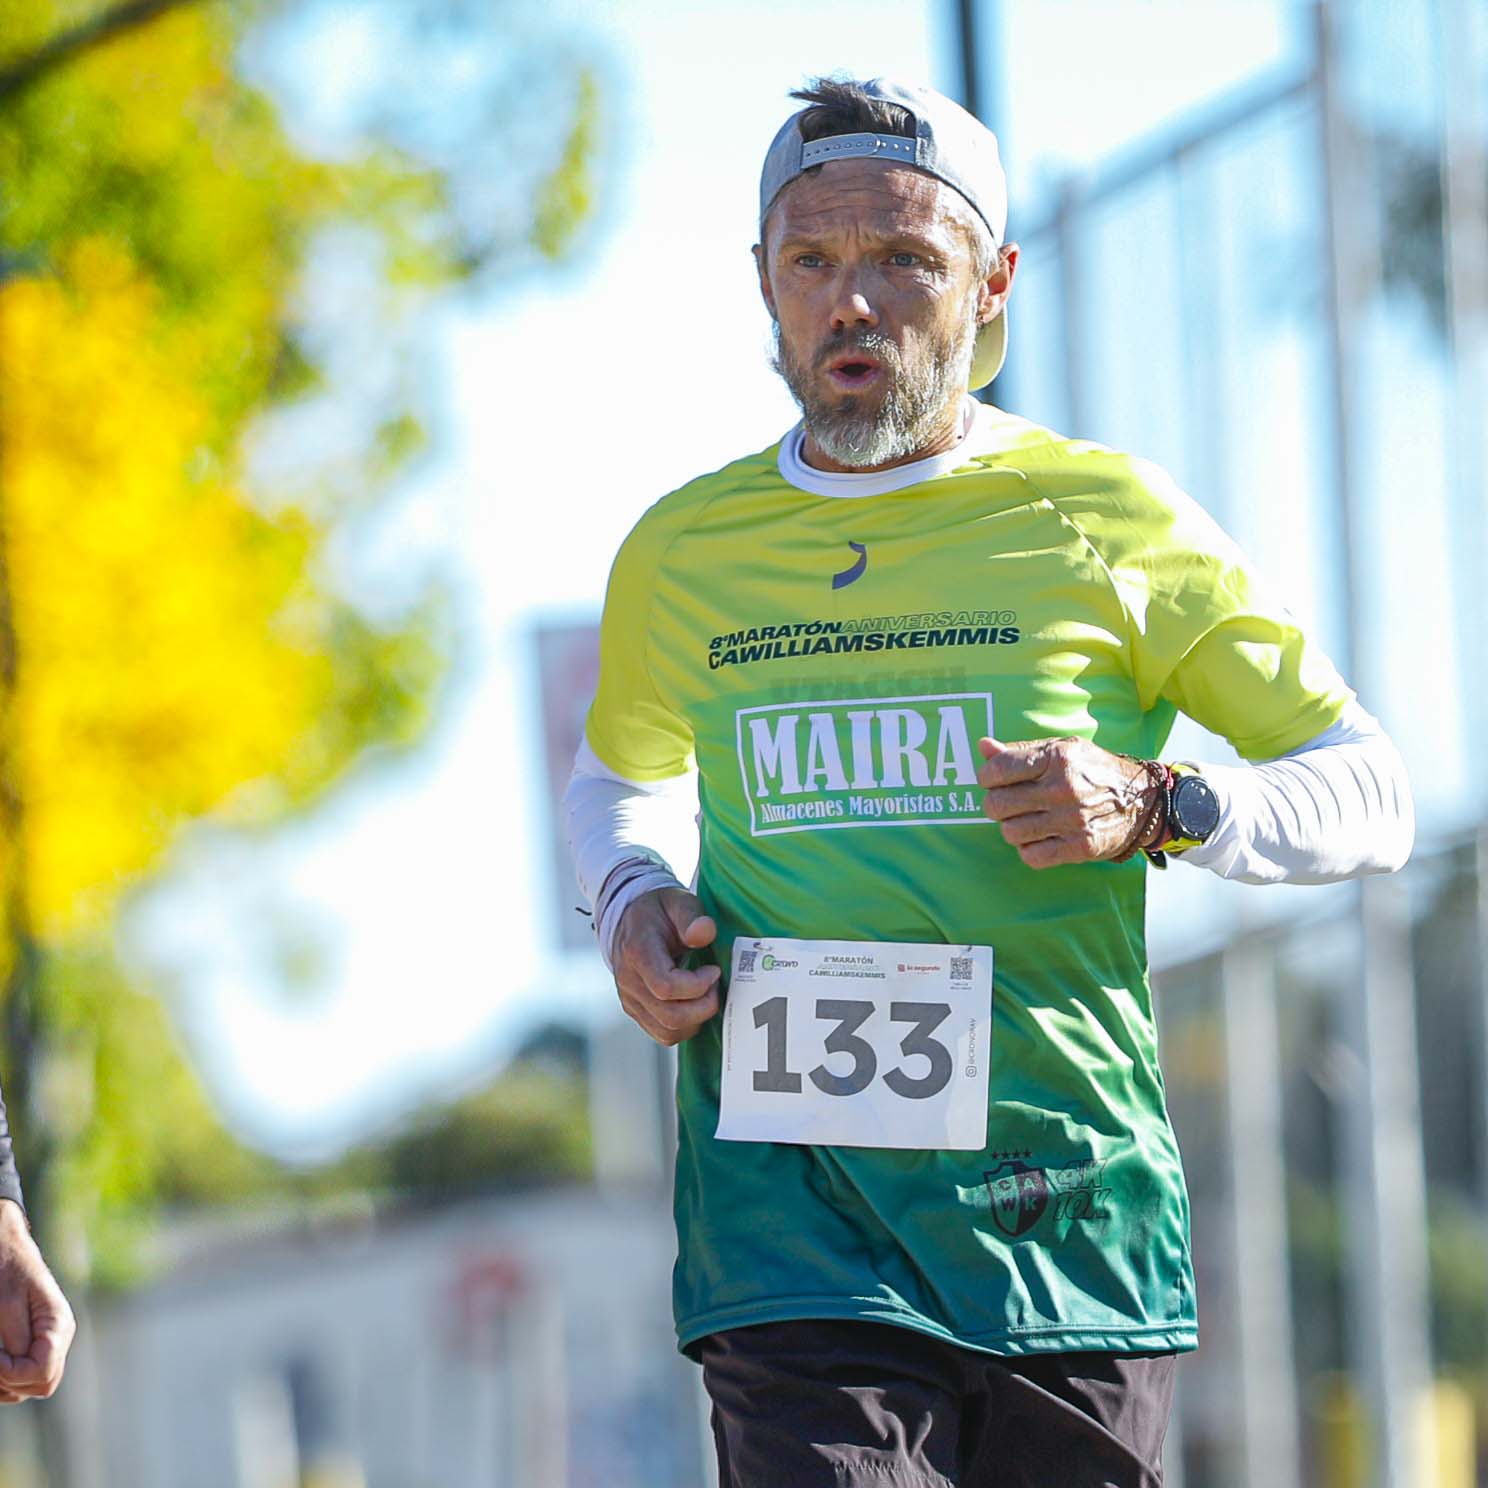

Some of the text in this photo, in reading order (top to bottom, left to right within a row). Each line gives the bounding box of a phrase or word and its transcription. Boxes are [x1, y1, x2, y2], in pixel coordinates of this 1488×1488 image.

[708, 626, 1020, 670] CAWILLIAMSKEMMIS
[748, 705, 979, 798] MAIRA
[760, 791, 981, 824] Almacenes Mayoristas S.A.
[752, 996, 953, 1100] 133
